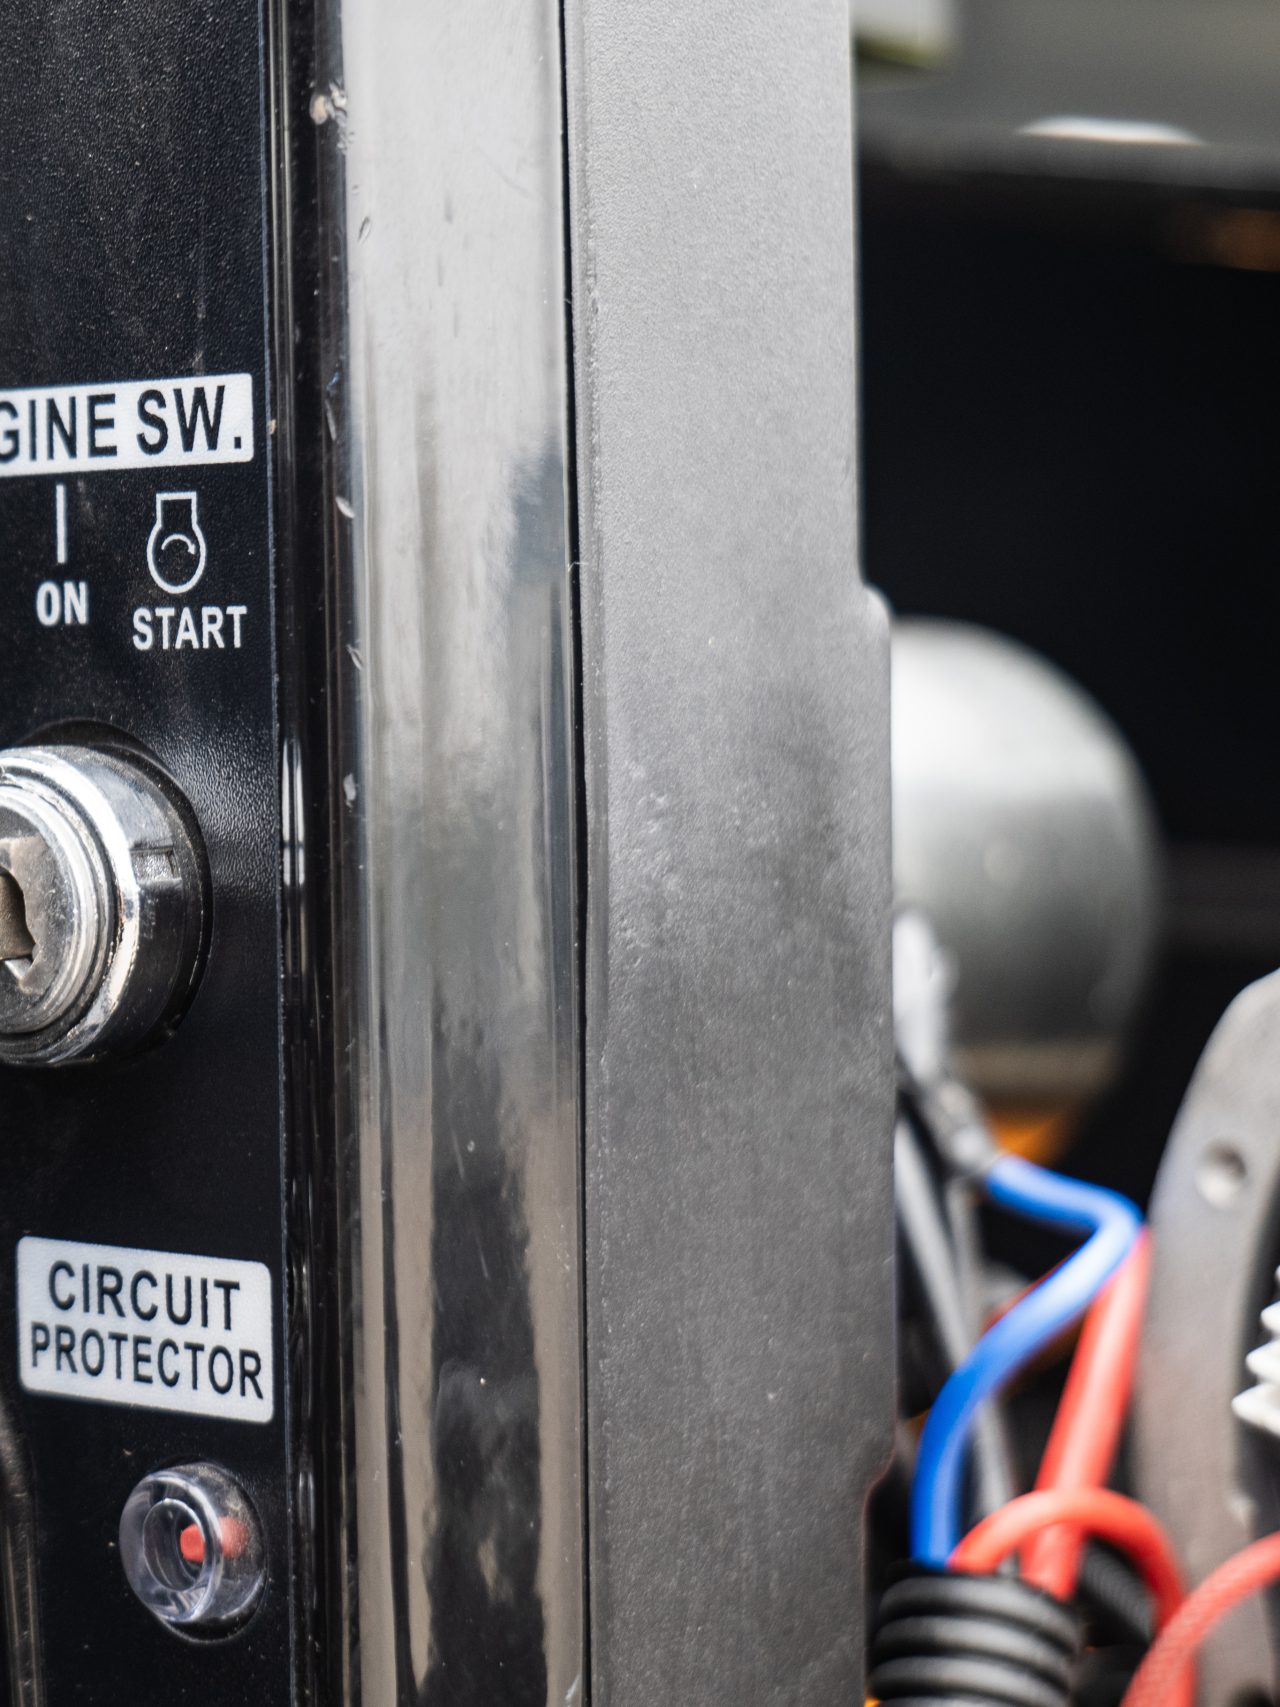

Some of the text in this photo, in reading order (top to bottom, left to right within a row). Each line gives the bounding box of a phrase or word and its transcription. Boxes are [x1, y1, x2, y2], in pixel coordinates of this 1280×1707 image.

[135, 384, 242, 456] SW.
[36, 581, 88, 626] ON
[132, 605, 248, 651] START
[48, 1260, 240, 1331] CIRCUIT
[30, 1321, 264, 1400] PROTECTOR
